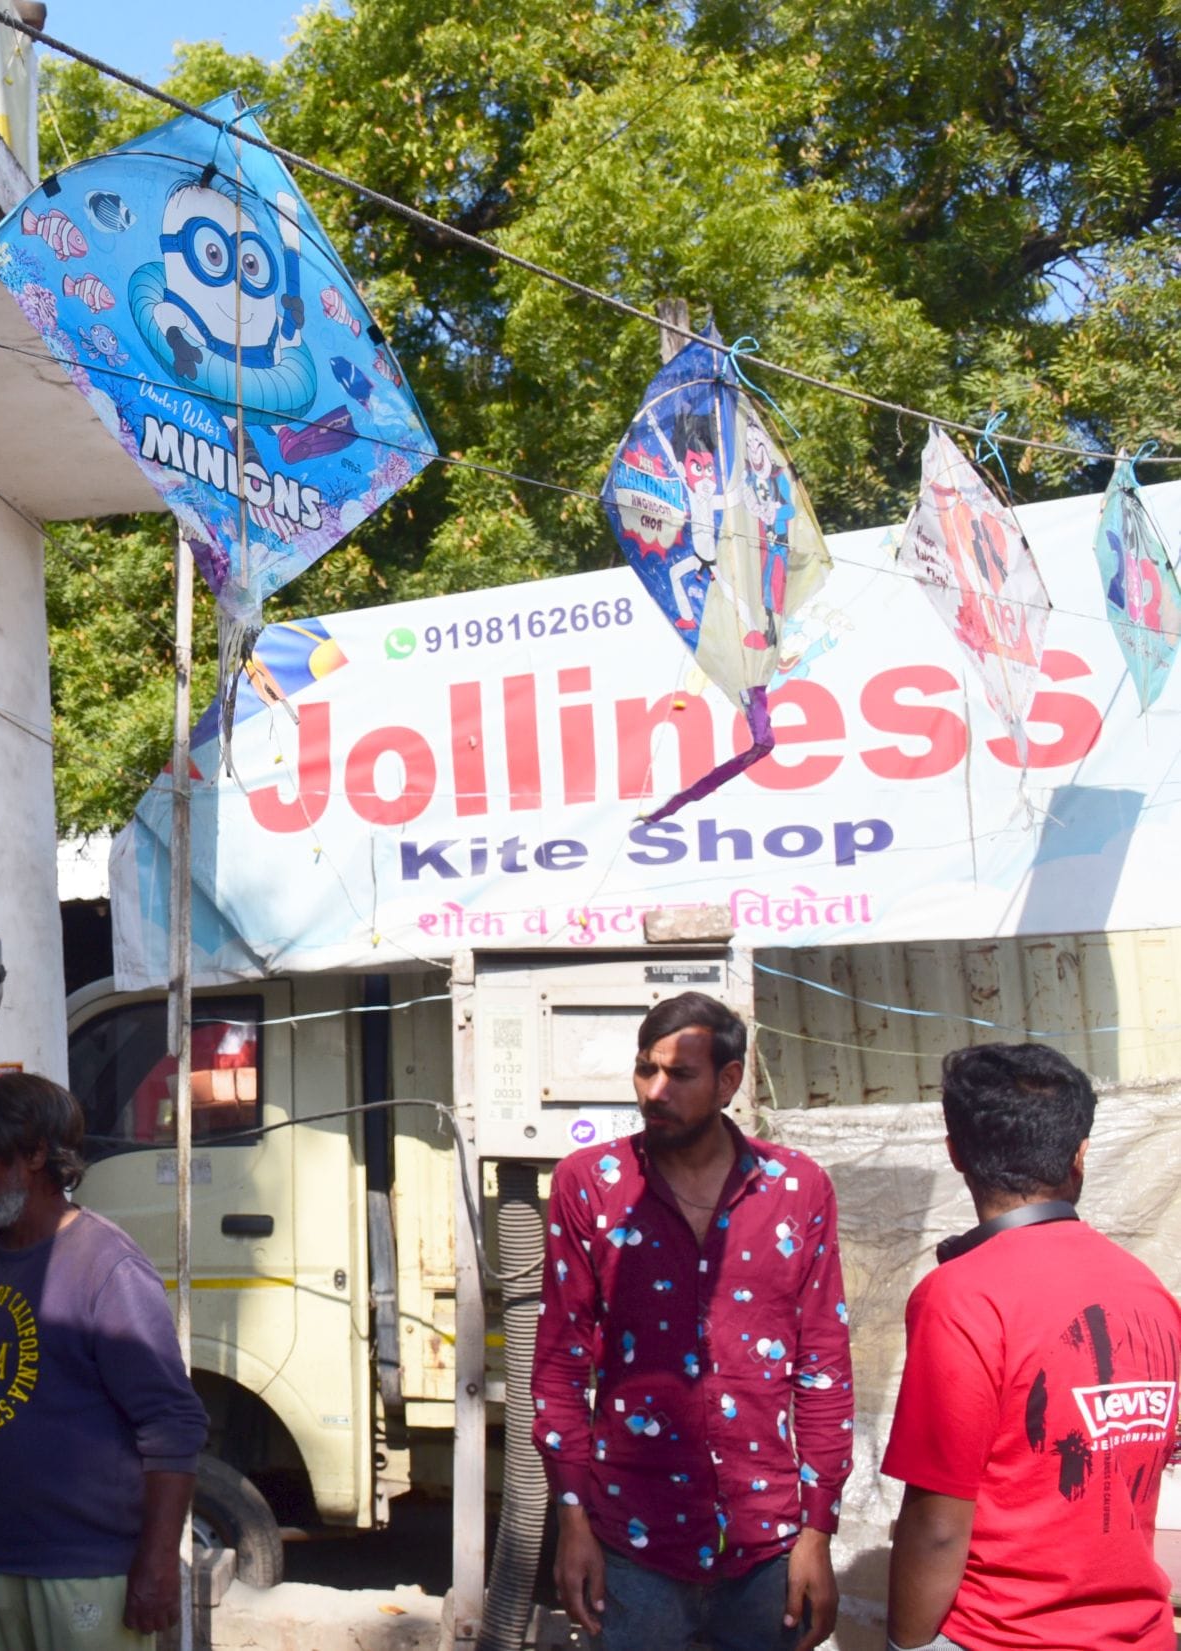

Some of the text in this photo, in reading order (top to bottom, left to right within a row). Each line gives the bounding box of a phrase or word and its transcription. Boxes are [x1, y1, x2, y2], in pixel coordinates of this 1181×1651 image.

[138, 373, 220, 440] Under Water
[140, 414, 323, 531] MINIONS
[424, 597, 634, 653] 9198162668
[247, 648, 1103, 834] Jolliness
[399, 813, 894, 881] Kite Shop
[523, 907, 549, 935] व
[567, 902, 707, 945] फुट
[730, 885, 874, 933] विक्रेता
[7, 1292, 39, 1403] CALIFORNIA
